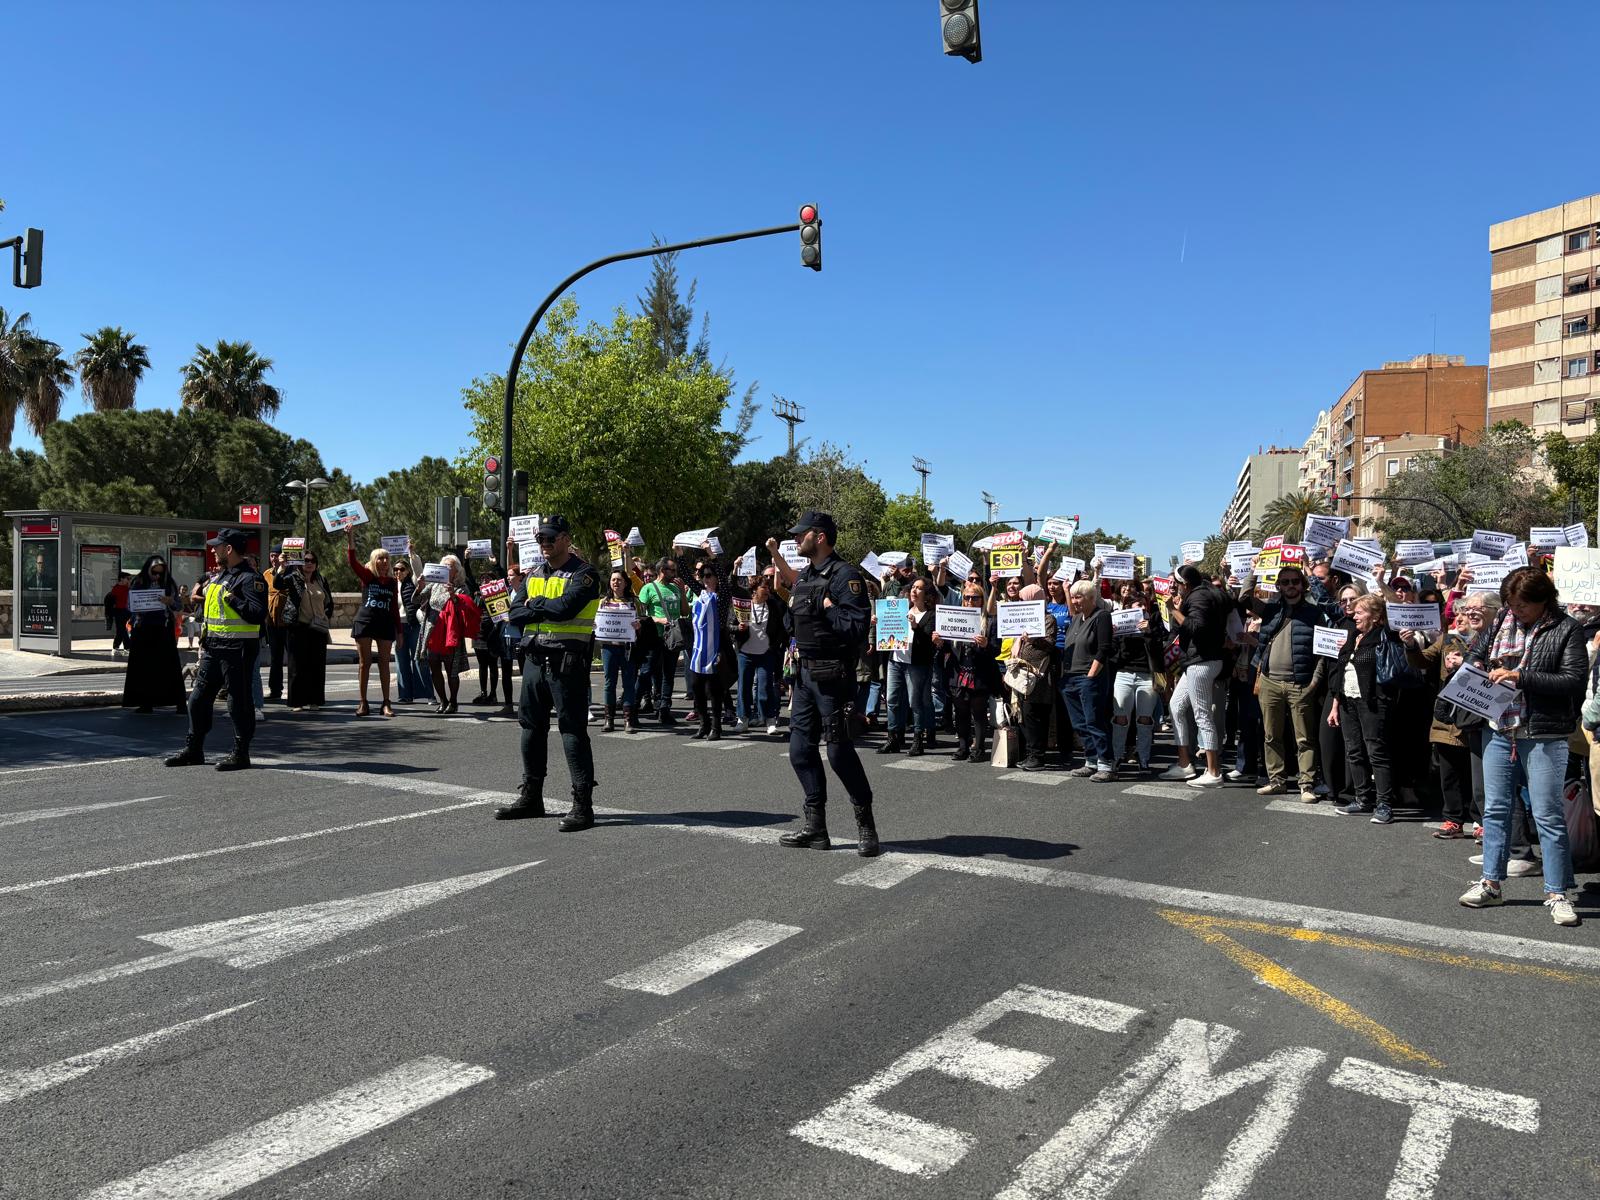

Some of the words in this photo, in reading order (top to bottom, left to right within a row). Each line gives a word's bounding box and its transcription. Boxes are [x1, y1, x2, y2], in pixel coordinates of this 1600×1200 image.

[994, 532, 1022, 544] STOP
[1355, 555, 1369, 564] SOMOS
[482, 582, 504, 596] STOP
[1153, 580, 1168, 592] STOP
[941, 625, 975, 633] RECORTABLES
[1480, 680, 1493, 688] NO
[1464, 694, 1489, 710] LLENGUA
[790, 984, 1540, 1200] EMT
